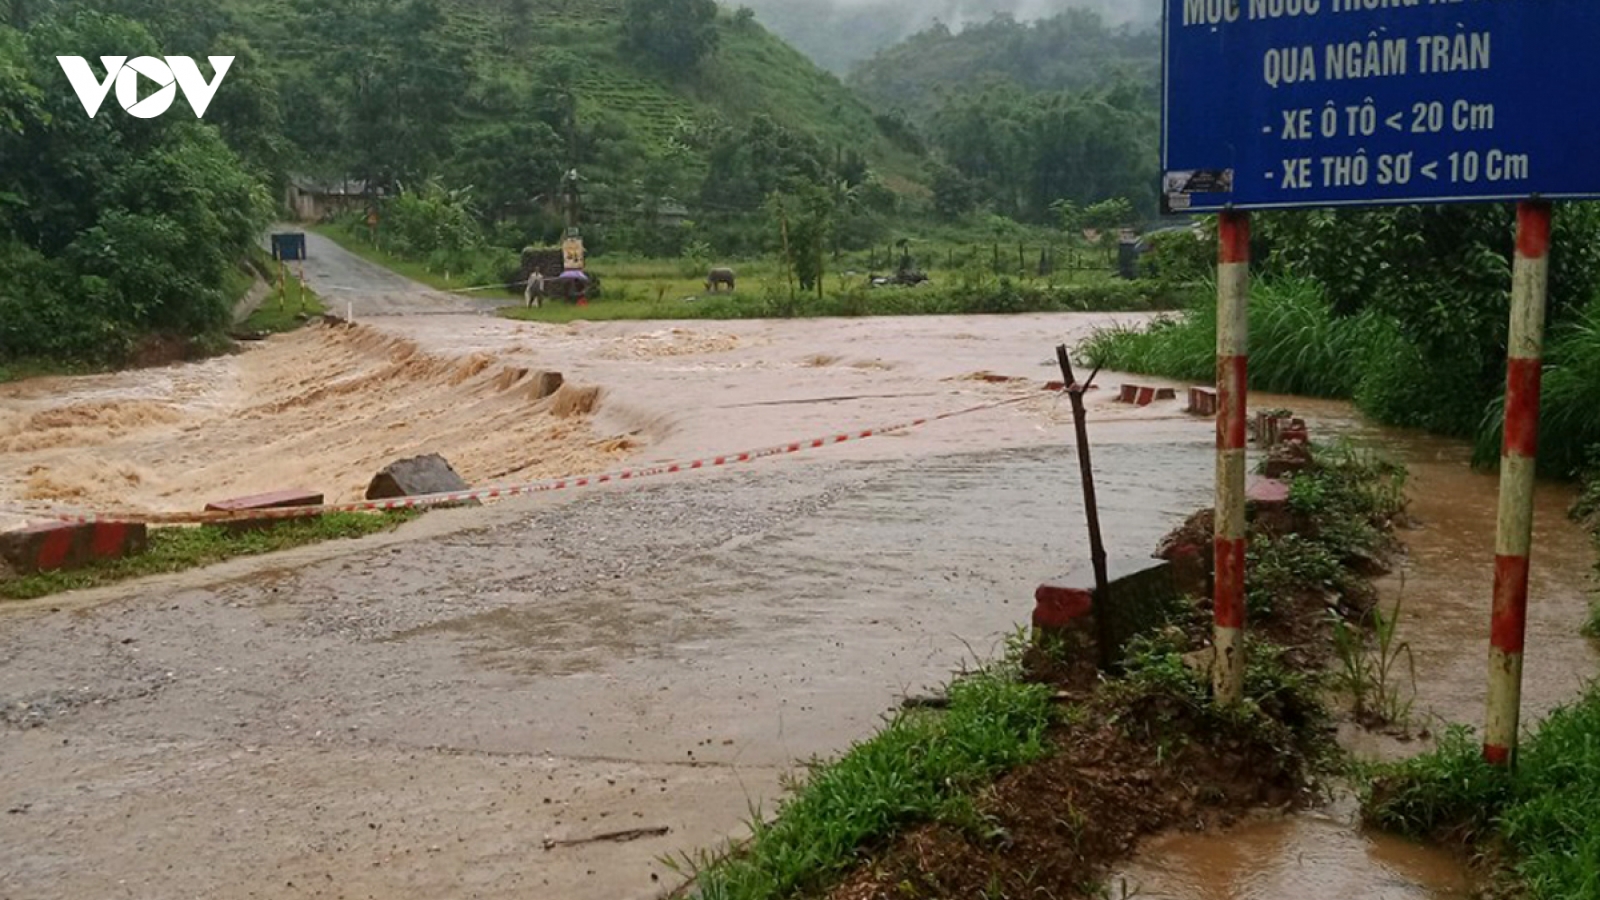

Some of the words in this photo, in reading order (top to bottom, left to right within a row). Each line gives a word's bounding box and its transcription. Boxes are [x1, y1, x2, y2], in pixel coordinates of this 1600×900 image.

[1263, 46, 1316, 88] QUA
[1325, 25, 1406, 80] NGẦM
[1416, 22, 1490, 73] TRÀN
[1281, 108, 1312, 140] XE
[1321, 99, 1337, 137] Ô
[1345, 96, 1376, 136] TÔ
[1411, 101, 1443, 132] 20
[1452, 99, 1494, 131] Cm
[1281, 158, 1312, 189] XE
[1321, 147, 1368, 187] THÔ
[1376, 151, 1413, 184] SƠ
[1448, 150, 1479, 183] 10
[1486, 149, 1529, 181] Cm
